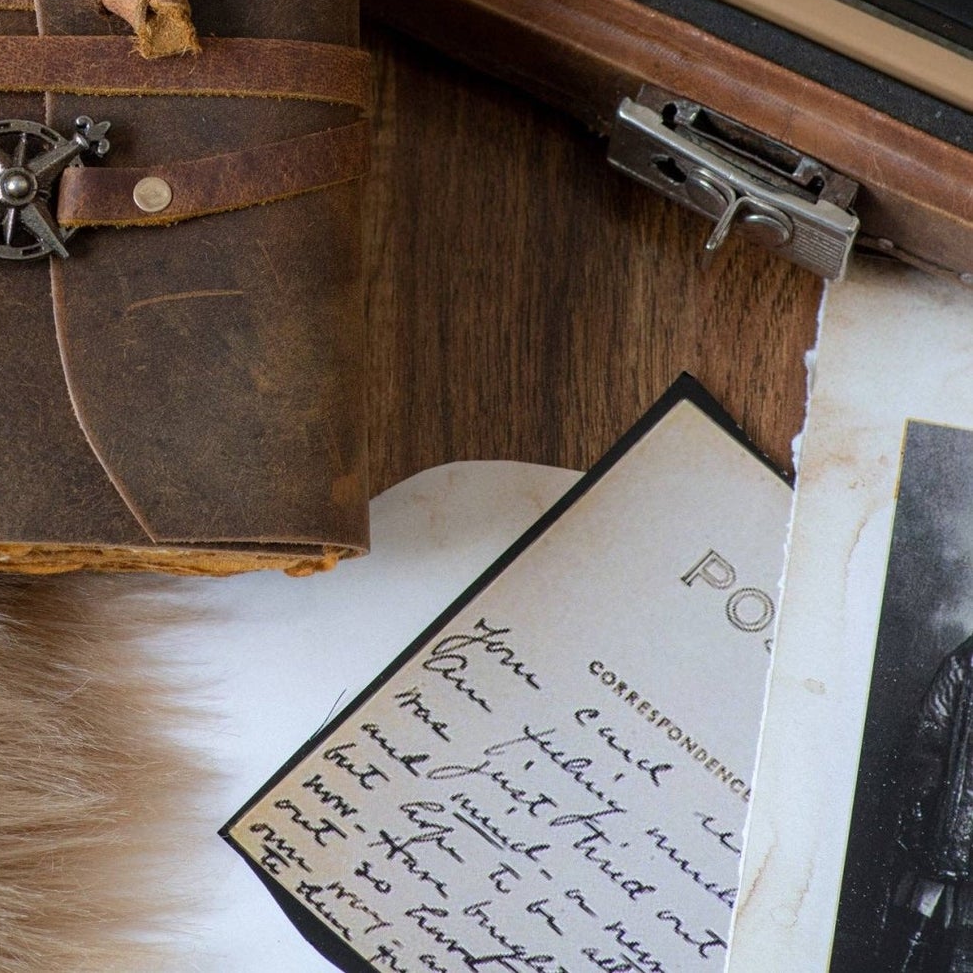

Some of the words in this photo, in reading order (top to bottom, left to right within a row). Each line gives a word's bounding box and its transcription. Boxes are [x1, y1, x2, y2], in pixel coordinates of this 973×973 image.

[680, 547, 775, 654] PO
[360, 723, 431, 778] and
[574, 708, 675, 787] card
[274, 799, 348, 848] out
[354, 860, 393, 895] so
[323, 742, 391, 791] but
[526, 898, 564, 938] be
[427, 759, 558, 818] just
[573, 820, 657, 901] tired
[657, 910, 728, 959] out
